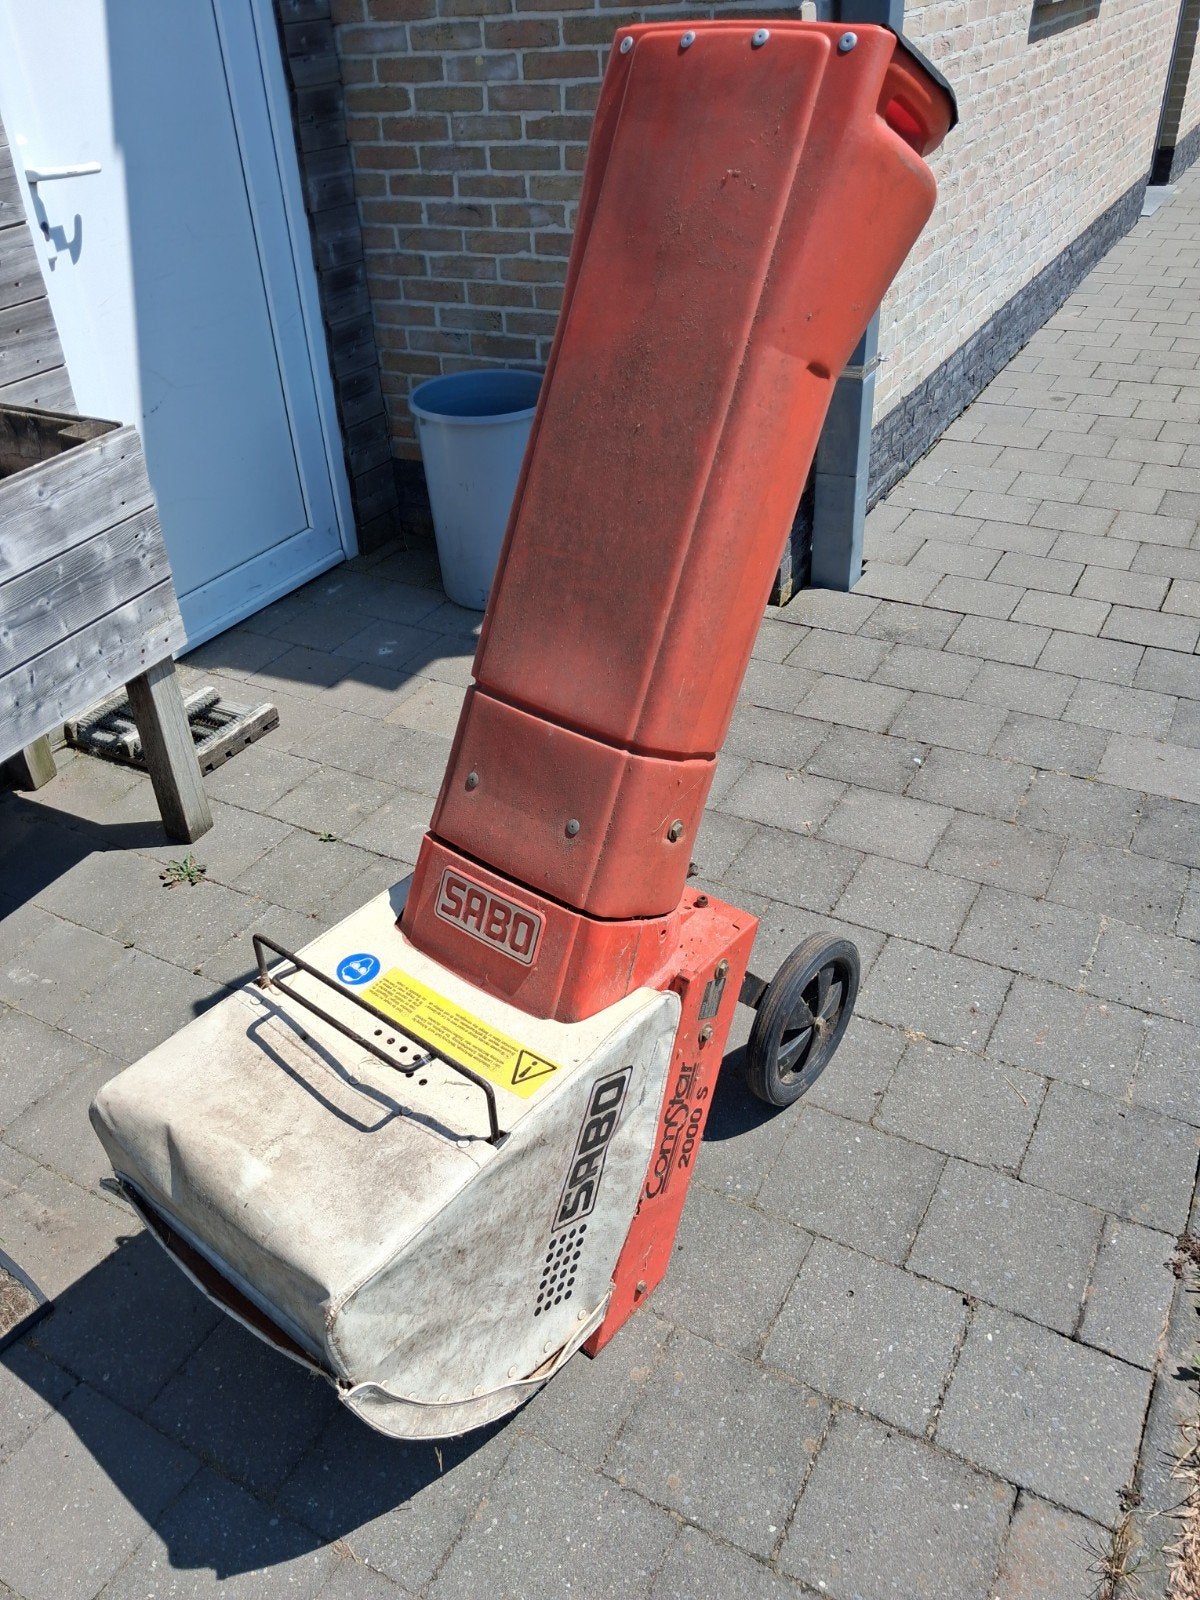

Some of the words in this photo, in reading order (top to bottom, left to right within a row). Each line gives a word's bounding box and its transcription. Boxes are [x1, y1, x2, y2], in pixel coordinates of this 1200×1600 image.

[441, 876, 535, 956] SABO
[559, 1076, 626, 1222] SABO
[678, 1108, 703, 1169] 2000
[696, 1086, 709, 1101] S
